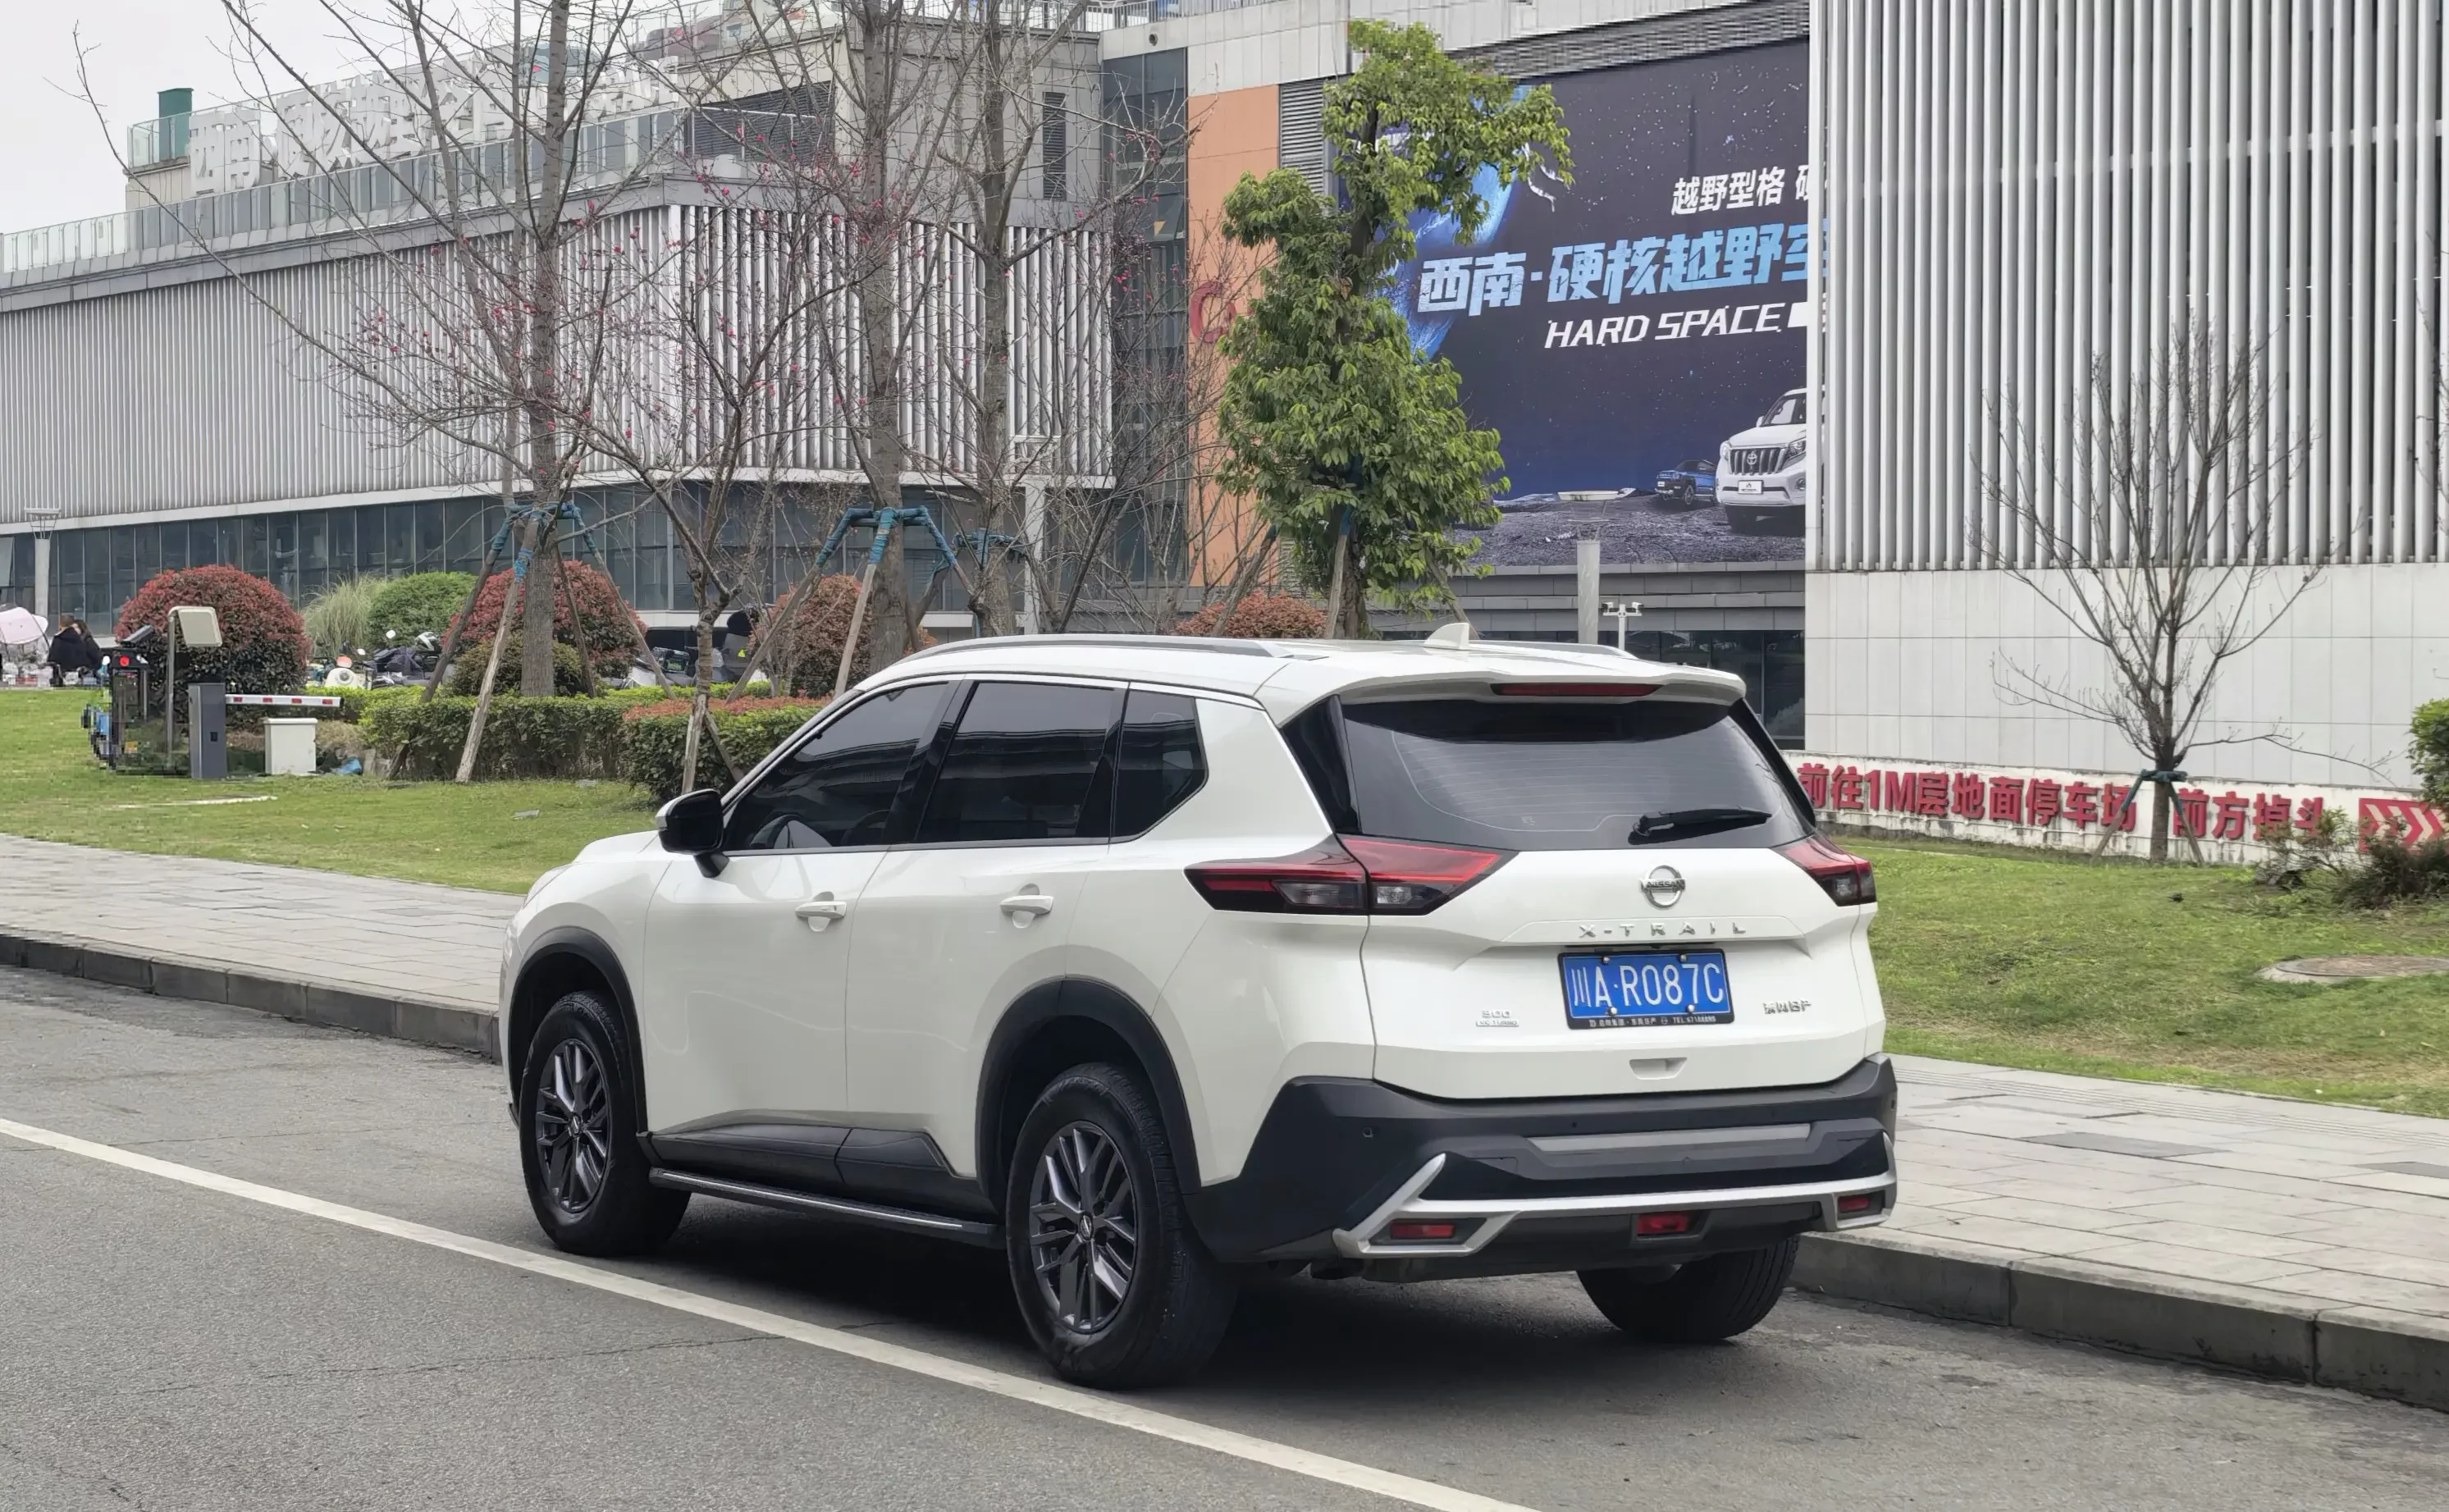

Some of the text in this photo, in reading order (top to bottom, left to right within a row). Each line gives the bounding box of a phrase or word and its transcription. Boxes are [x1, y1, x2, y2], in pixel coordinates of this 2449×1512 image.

[1671, 167, 1785, 216] 越野型格
[1544, 302, 1786, 349] HARD SPACE
[1797, 763, 2137, 832] 前往1M层地面停车场
[1579, 921, 1747, 938] X-TRAIL
